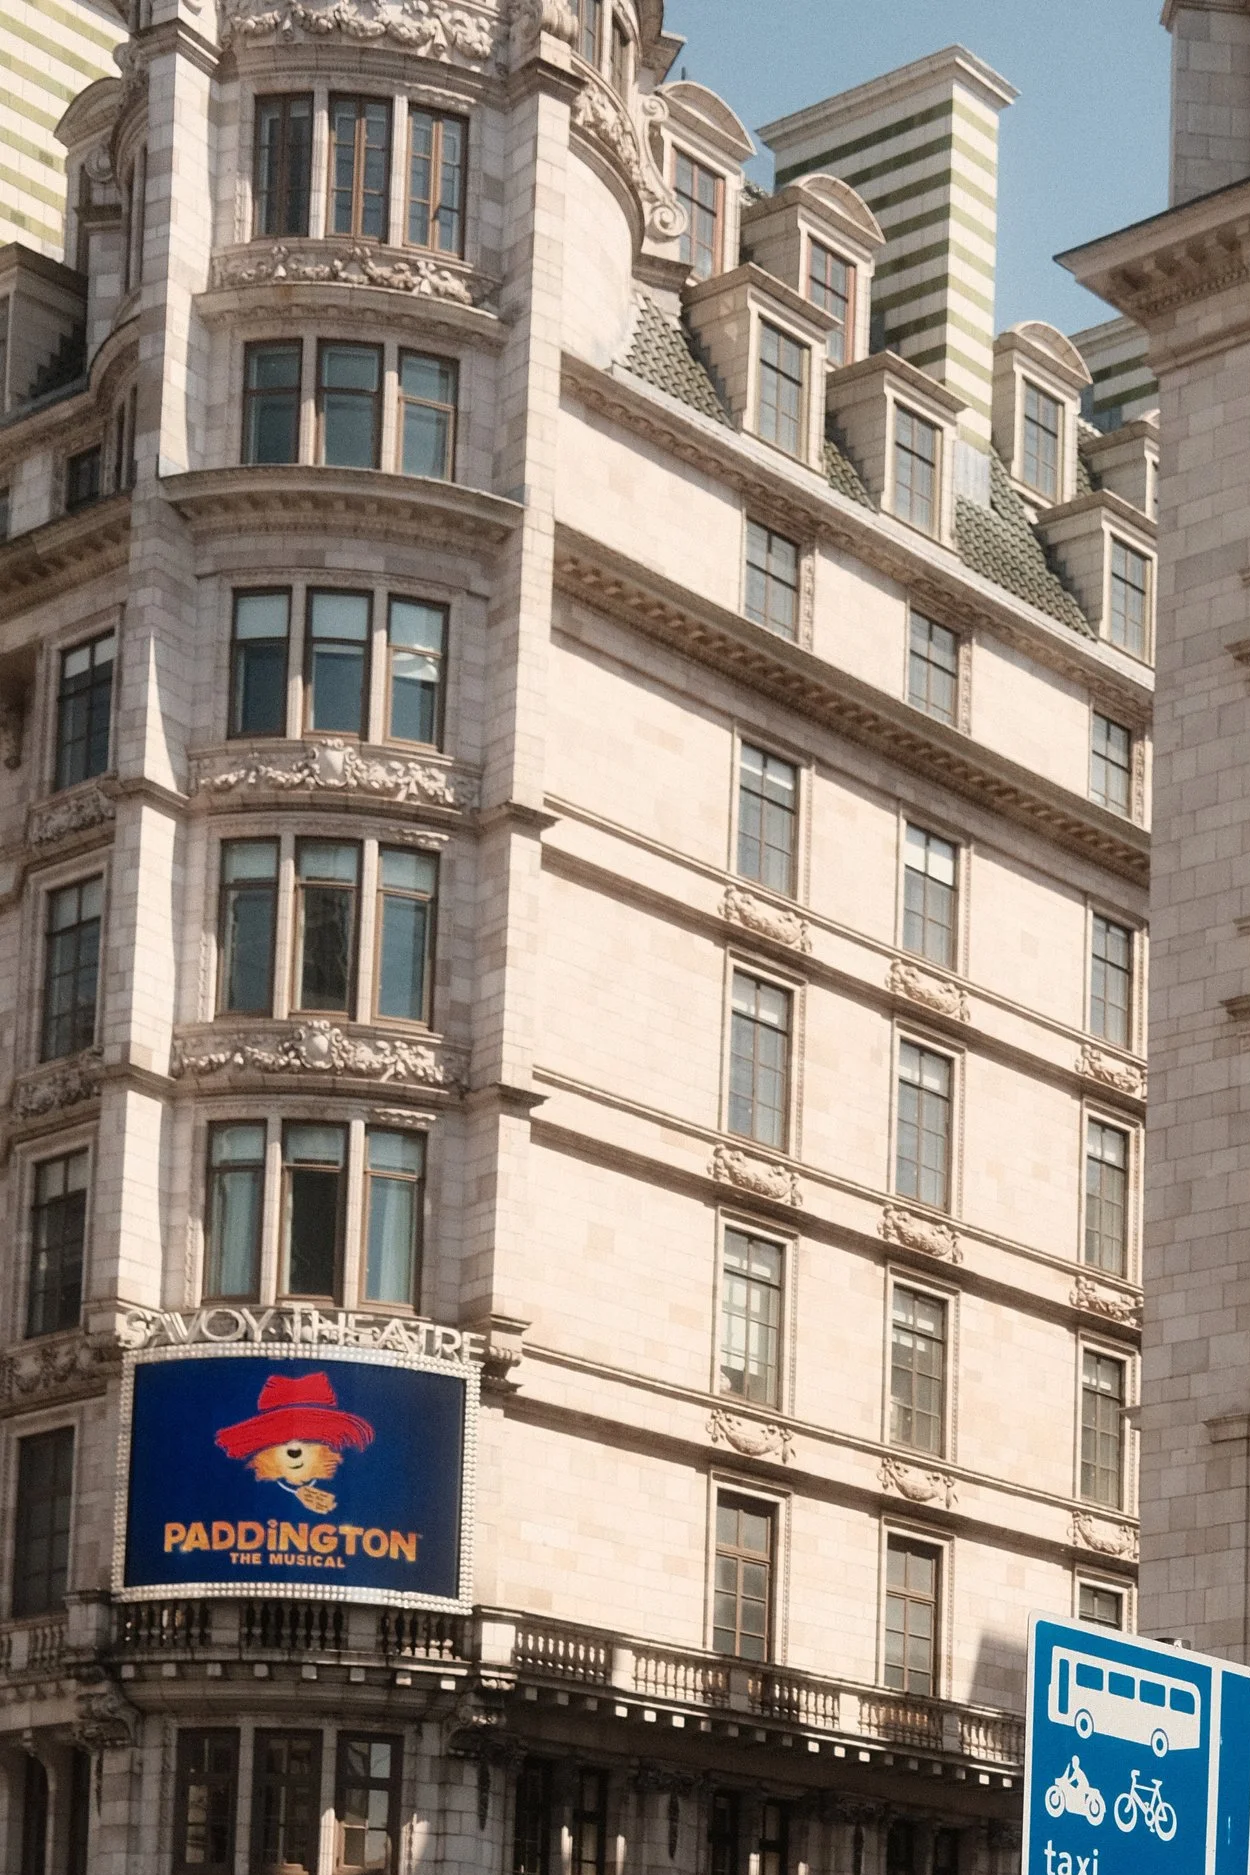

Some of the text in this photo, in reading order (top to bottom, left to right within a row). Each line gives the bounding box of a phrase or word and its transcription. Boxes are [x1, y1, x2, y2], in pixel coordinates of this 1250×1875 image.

[118, 1301, 487, 1368] SAVOY THEATRE
[230, 1552, 346, 1568] THE MUSICAL
